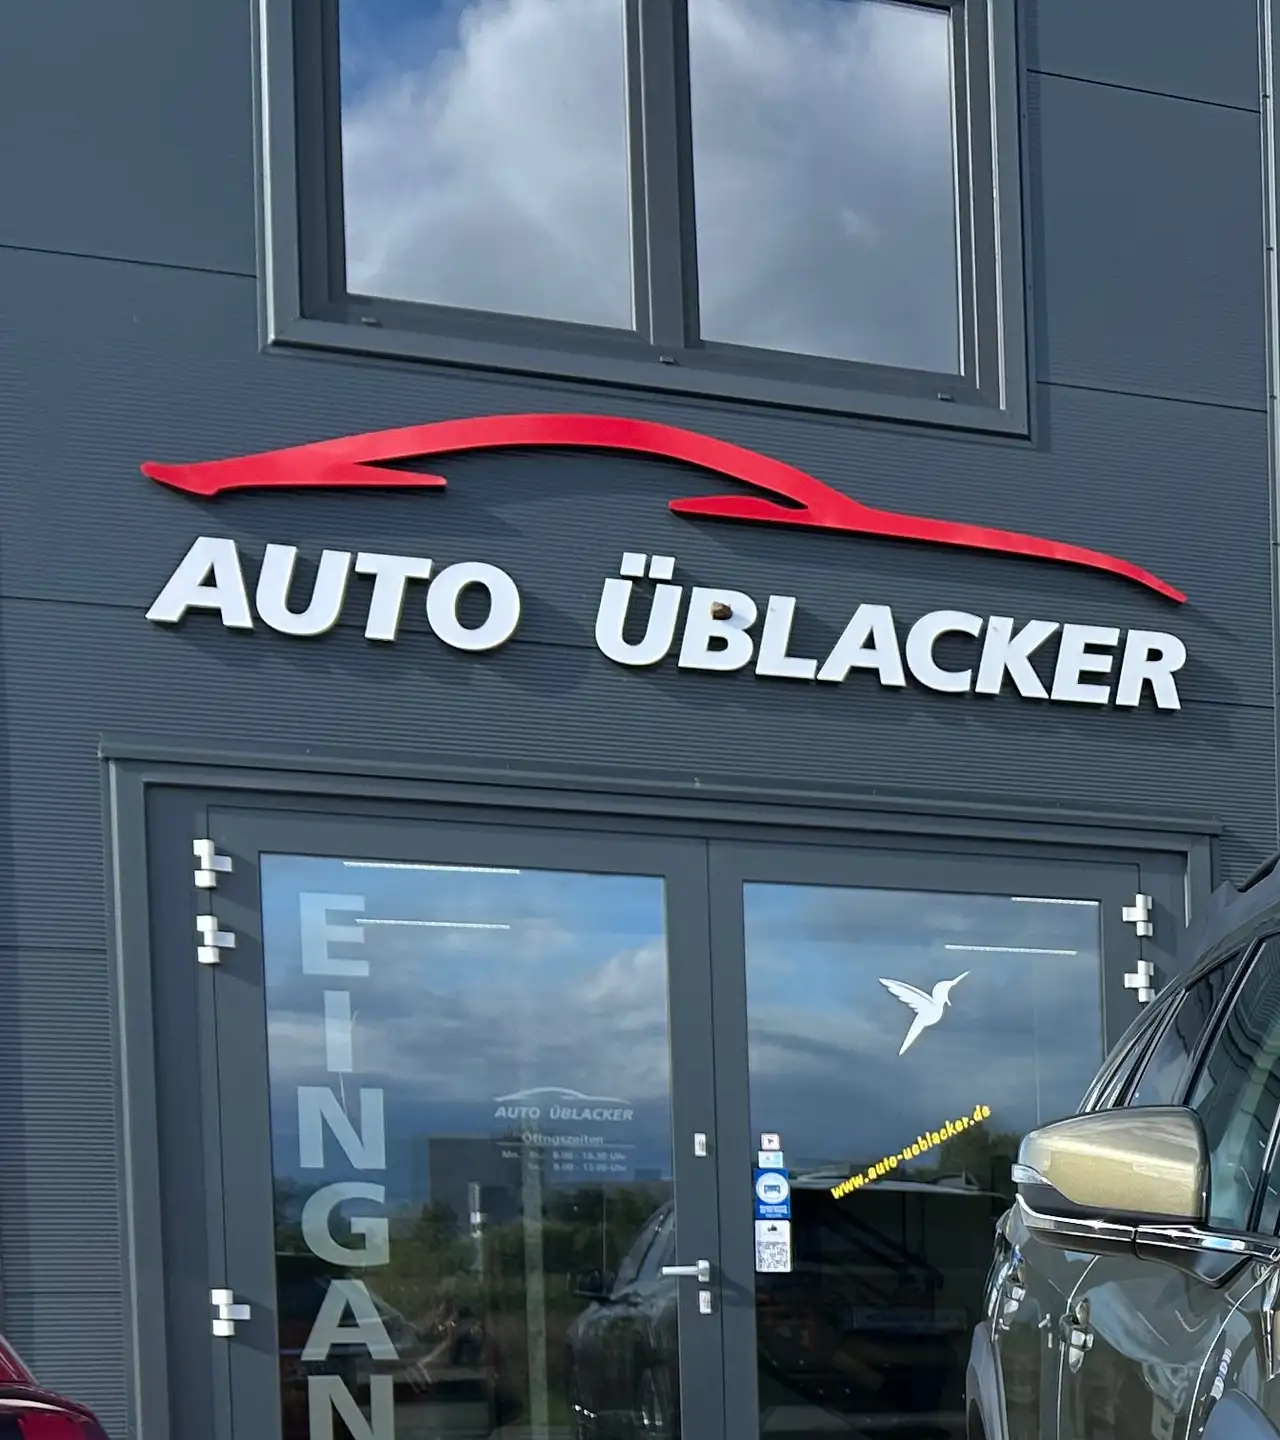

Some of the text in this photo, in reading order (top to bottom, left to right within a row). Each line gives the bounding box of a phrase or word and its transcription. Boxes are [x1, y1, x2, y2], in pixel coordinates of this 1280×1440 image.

[145, 534, 1188, 711] AUTO ÜBLACKER
[494, 1104, 634, 1121] AUTO ÜBLACKER
[830, 1104, 991, 1200] www.auto-ueblacker.de
